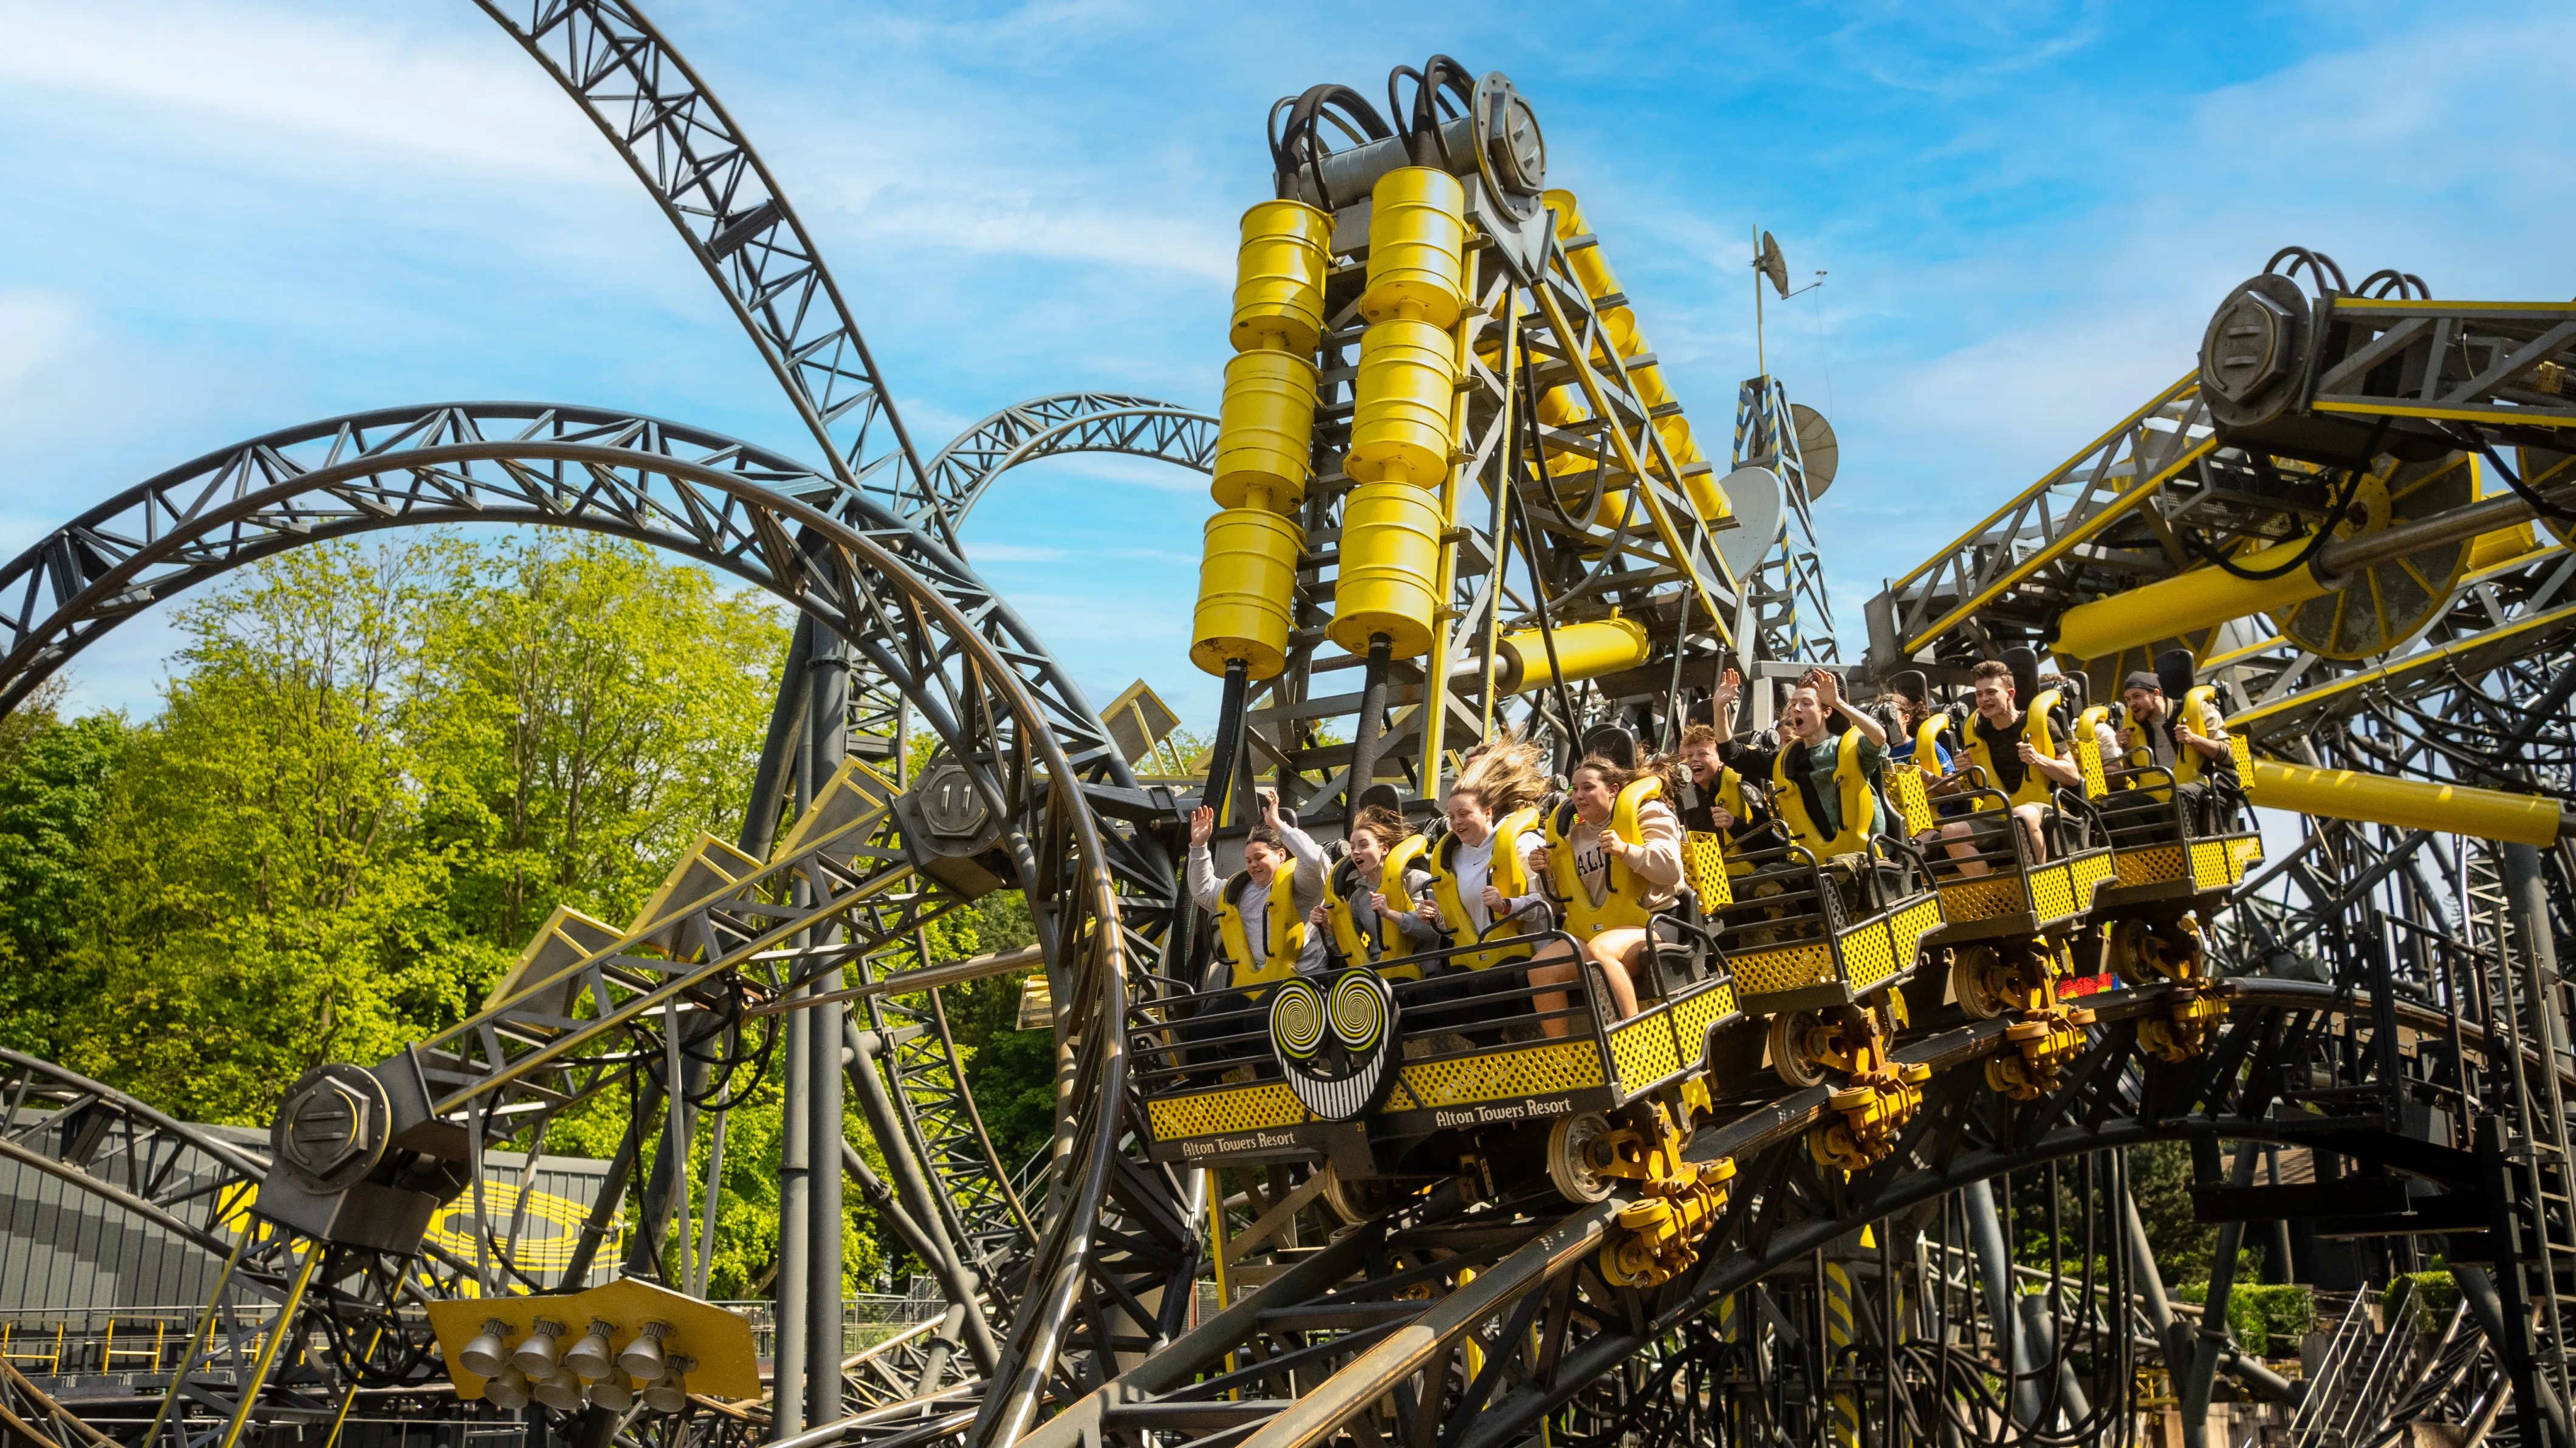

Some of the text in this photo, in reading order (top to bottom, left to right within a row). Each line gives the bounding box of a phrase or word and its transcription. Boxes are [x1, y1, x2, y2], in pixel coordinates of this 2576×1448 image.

[1436, 1098, 1572, 1127] Alton Towers Resort
[1182, 1131, 1296, 1156] Alton Towers Resort
